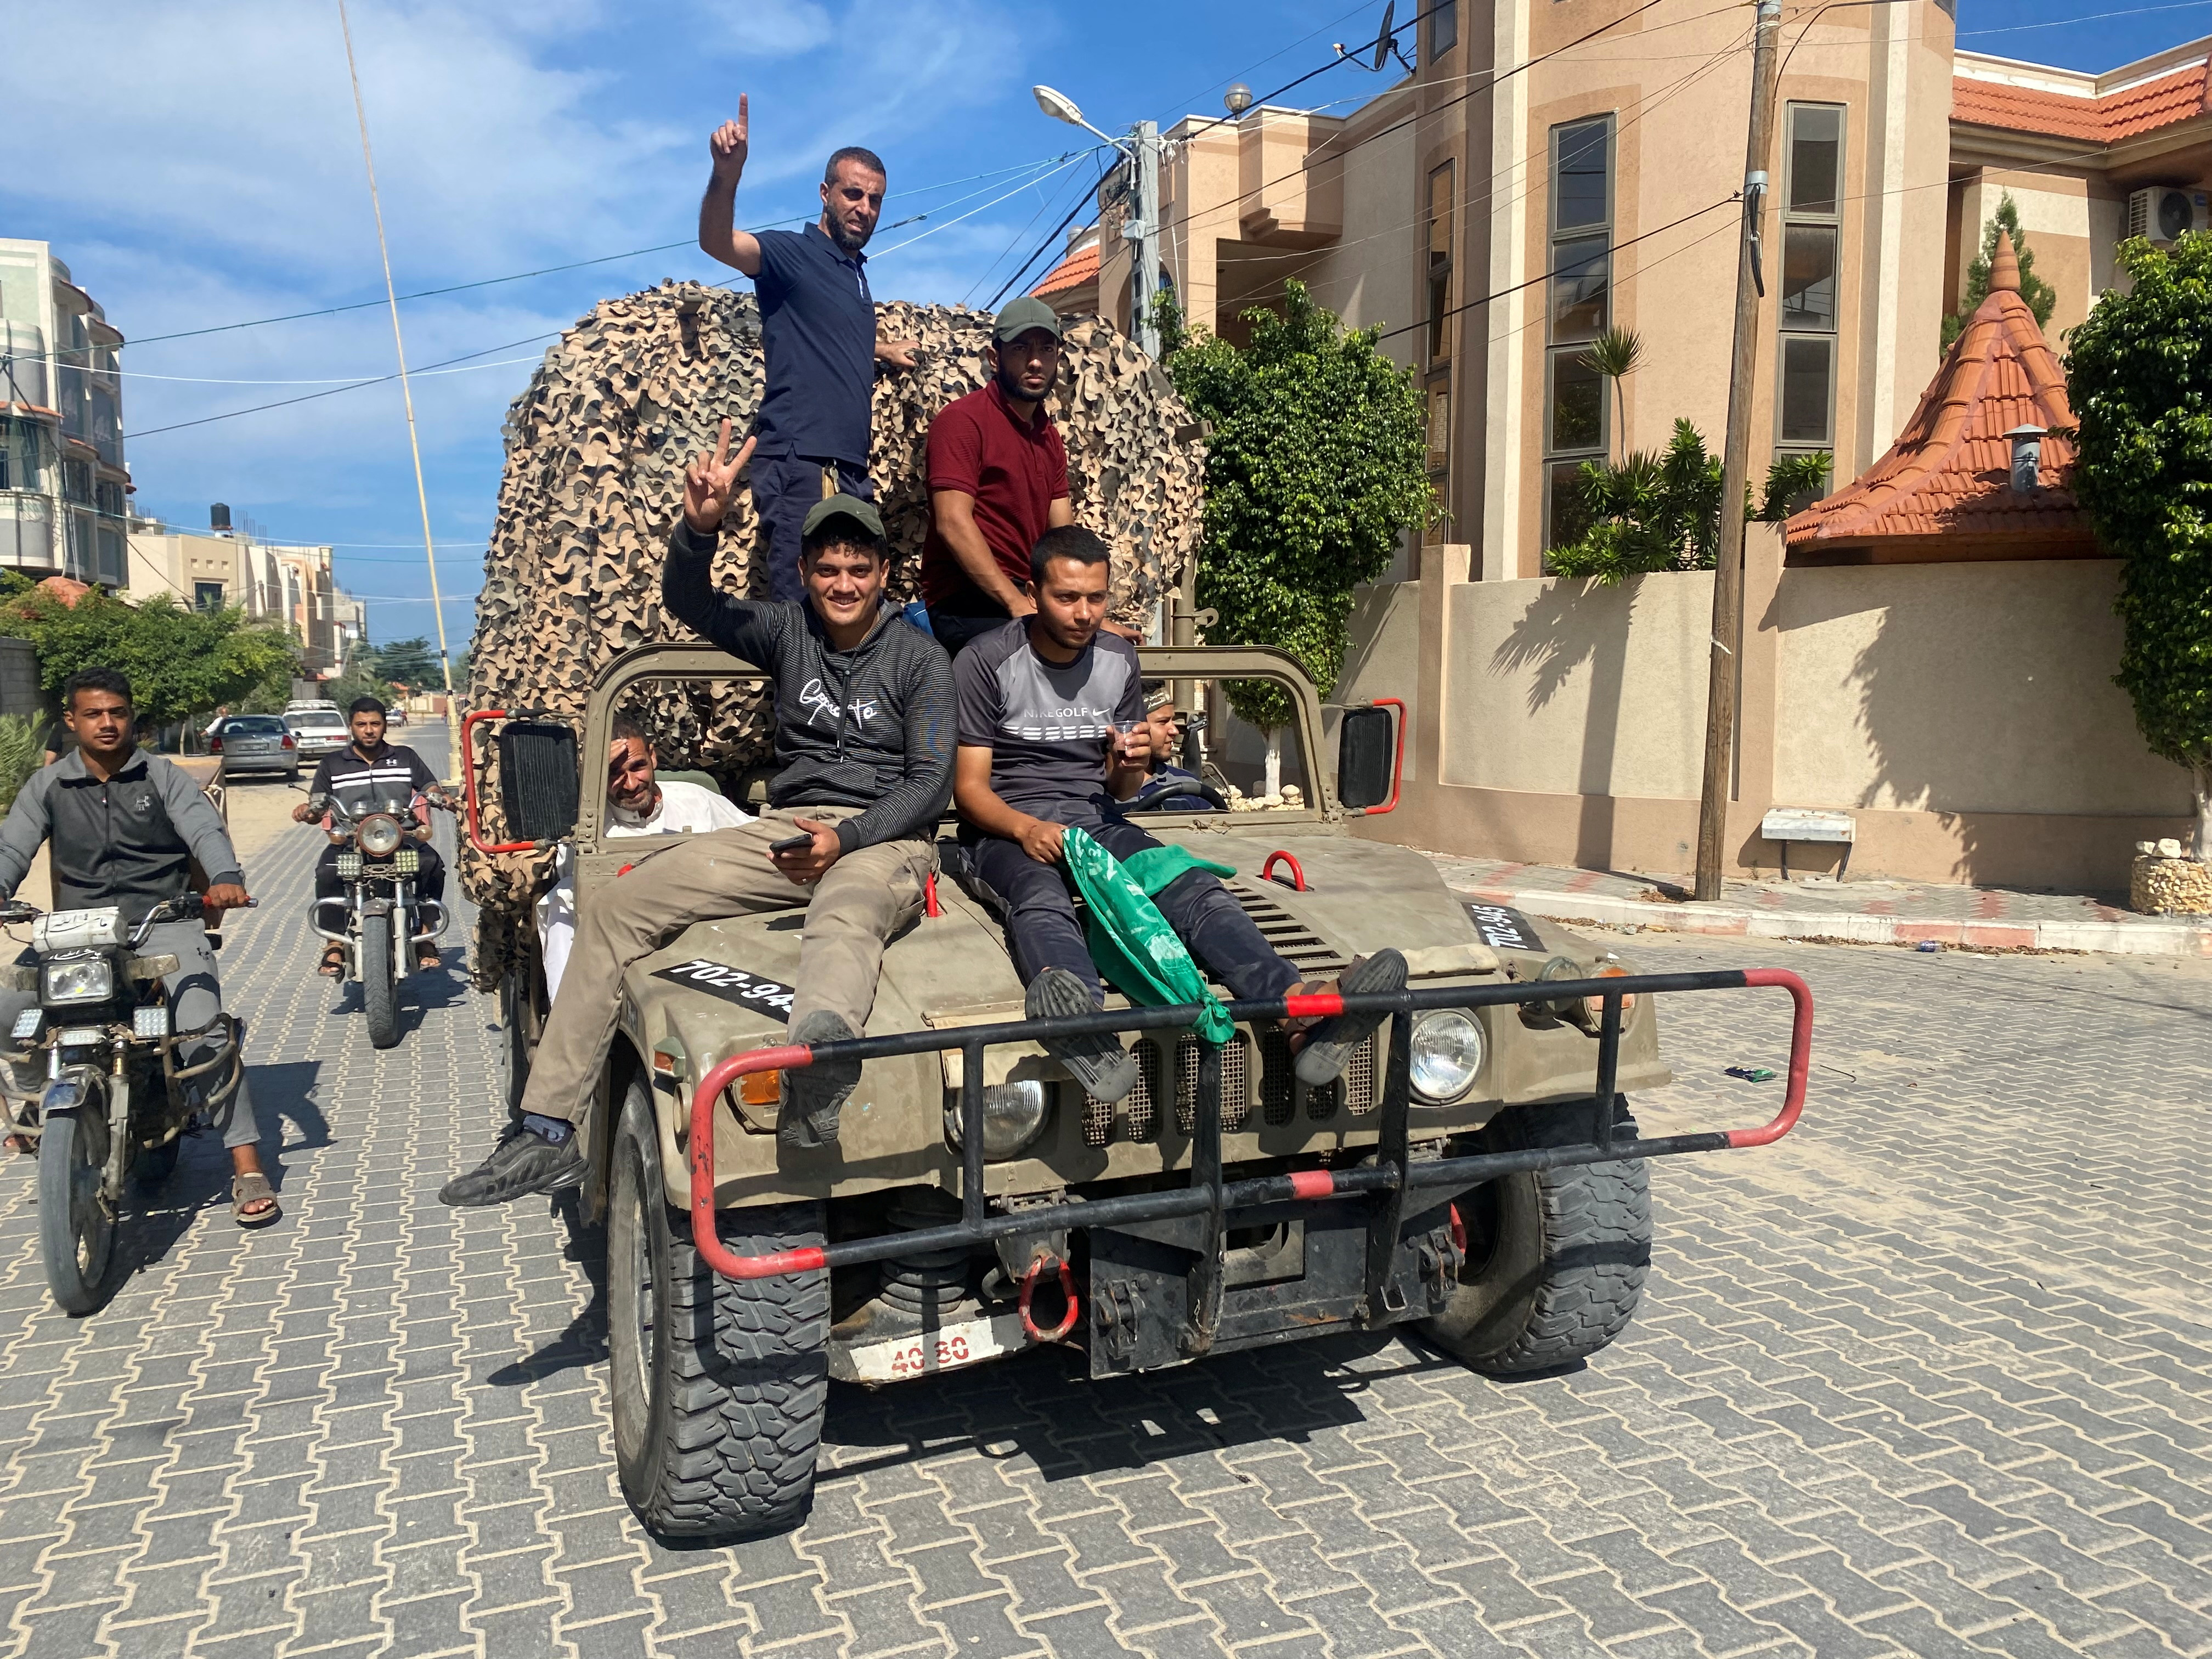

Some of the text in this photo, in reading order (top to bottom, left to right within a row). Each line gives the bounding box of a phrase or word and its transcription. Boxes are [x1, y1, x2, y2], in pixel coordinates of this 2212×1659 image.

[1024, 707, 1088, 718] NIKE GOLF
[1471, 905, 1529, 950] 702-945
